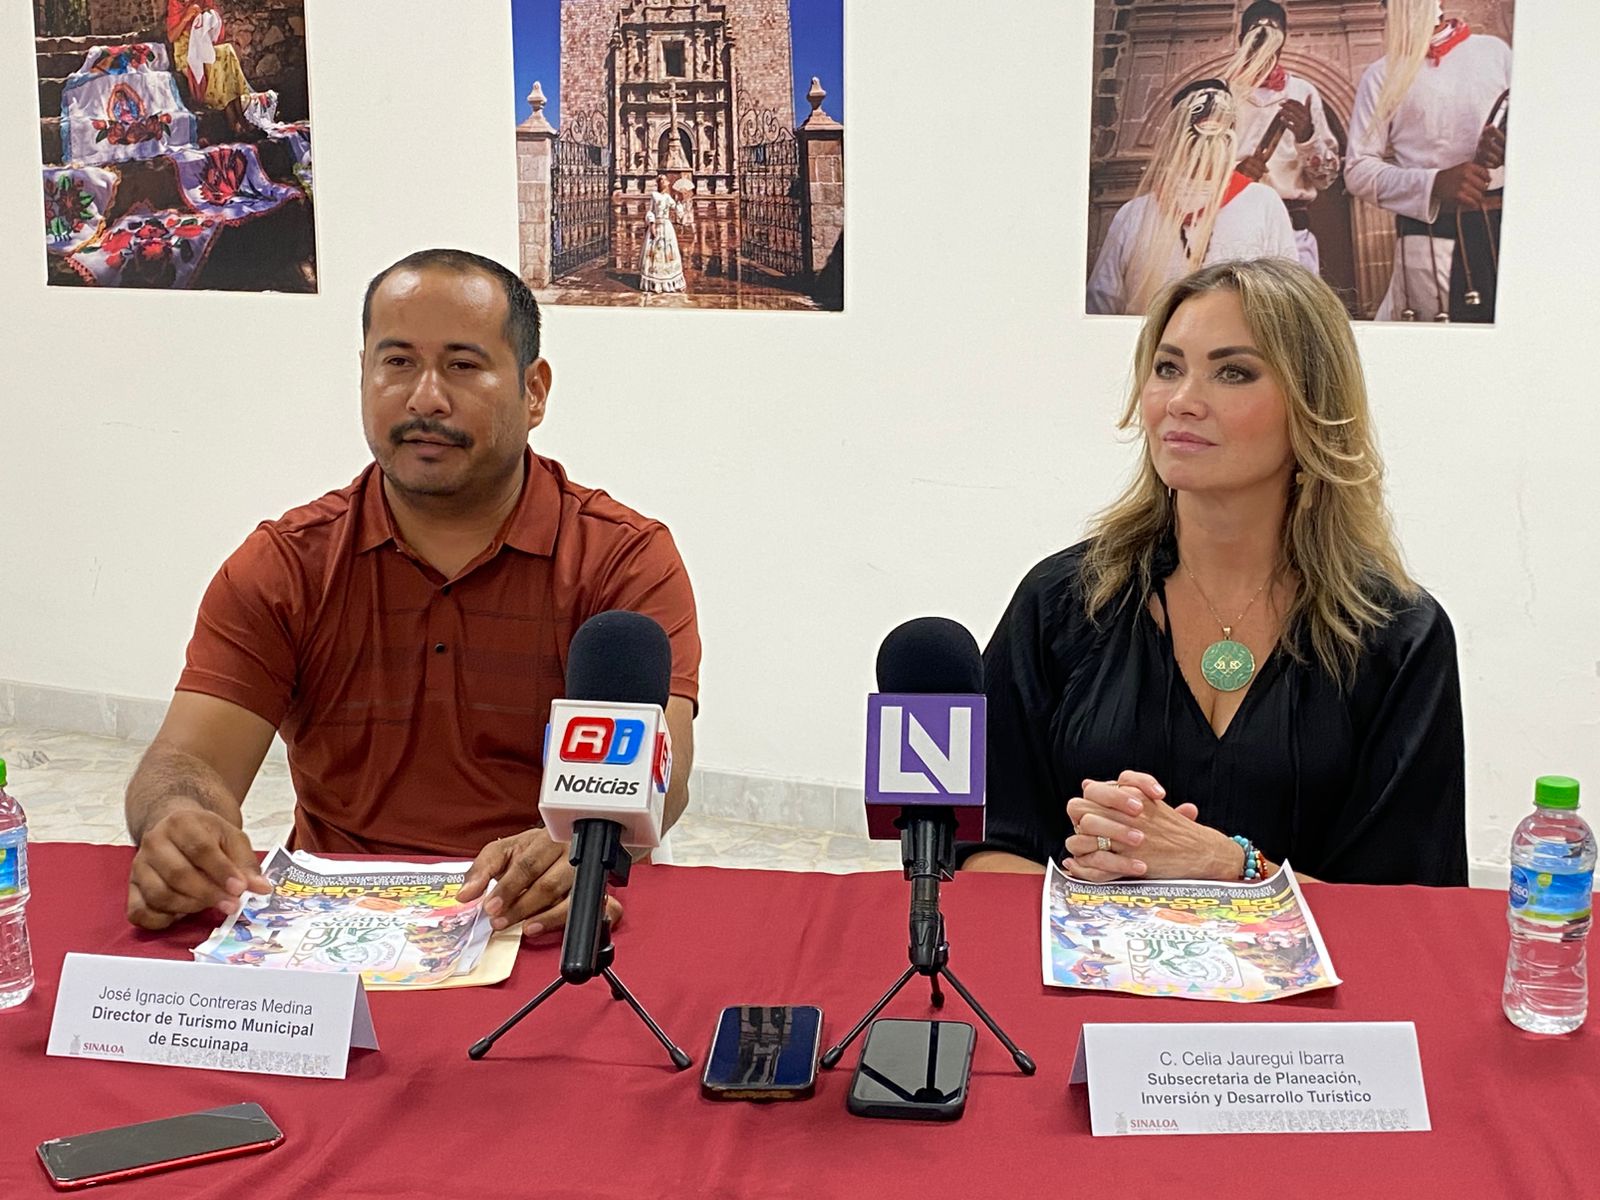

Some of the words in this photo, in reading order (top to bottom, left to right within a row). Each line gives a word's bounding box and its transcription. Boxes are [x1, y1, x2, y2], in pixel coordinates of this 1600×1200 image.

[879, 706, 971, 794] LN
[554, 774, 640, 795] Noticias
[99, 986, 131, 1002] José
[136, 988, 185, 1007] Ignacio
[189, 993, 257, 1012] Contreras
[262, 998, 313, 1015] Medina
[92, 1006, 151, 1023] Director
[154, 1011, 173, 1025] de
[178, 1013, 237, 1030] Turismo
[241, 1018, 314, 1038] Municipal
[83, 1042, 125, 1054] SINALOA
[149, 1032, 167, 1046] de
[171, 1033, 249, 1054] Escuinapa
[1160, 1051, 1177, 1066] C.
[1182, 1051, 1222, 1066] Celia
[1227, 1051, 1294, 1068] Jauregui
[1299, 1050, 1345, 1065] Ibarra
[1147, 1072, 1249, 1086] Subsecretaria
[1253, 1071, 1272, 1085] de
[1276, 1071, 1362, 1086] Planeación,
[1141, 1091, 1210, 1105] Inversión
[1213, 1093, 1222, 1107] y
[1227, 1091, 1304, 1104] Desarrollo
[1307, 1090, 1372, 1103] Turístico
[1130, 1119, 1179, 1128] SINALOA
